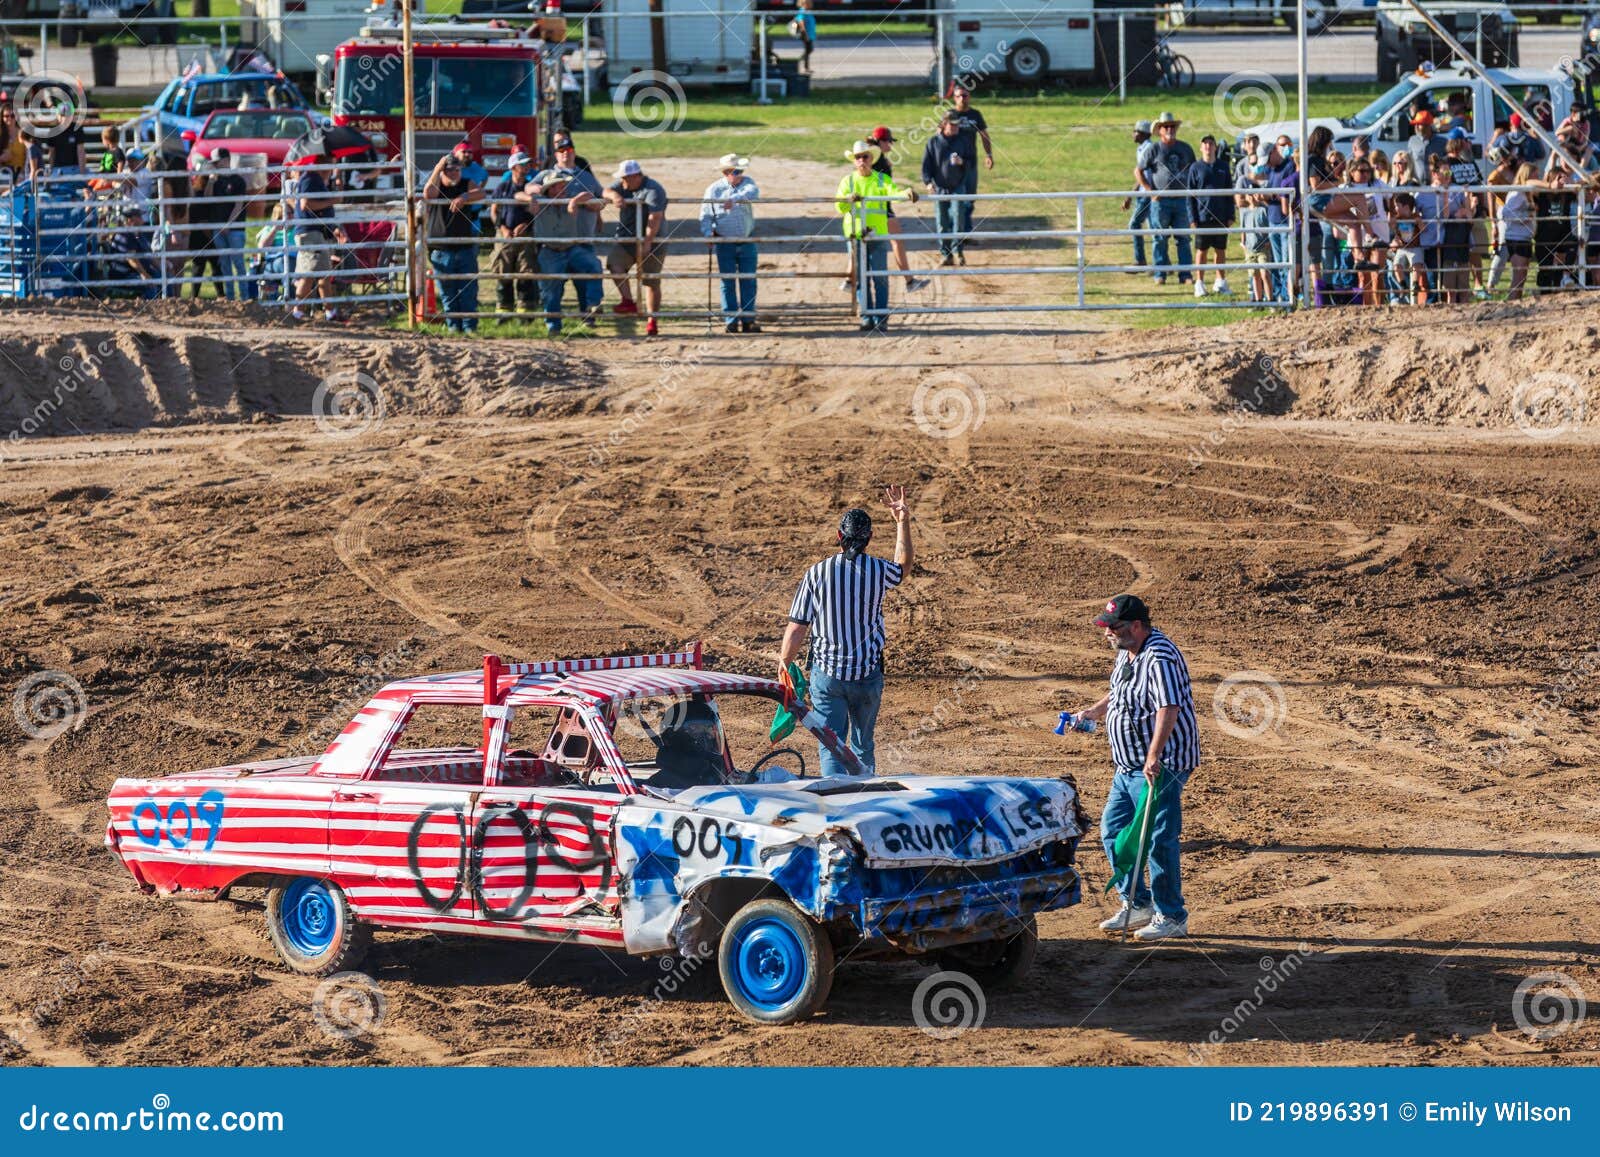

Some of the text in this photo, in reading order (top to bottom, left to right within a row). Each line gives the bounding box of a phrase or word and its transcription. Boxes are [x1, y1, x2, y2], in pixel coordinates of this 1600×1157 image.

[413, 118, 466, 130] UCHANAN
[131, 789, 226, 852] 009
[1000, 796, 1060, 838] LEE
[407, 801, 612, 920] 009
